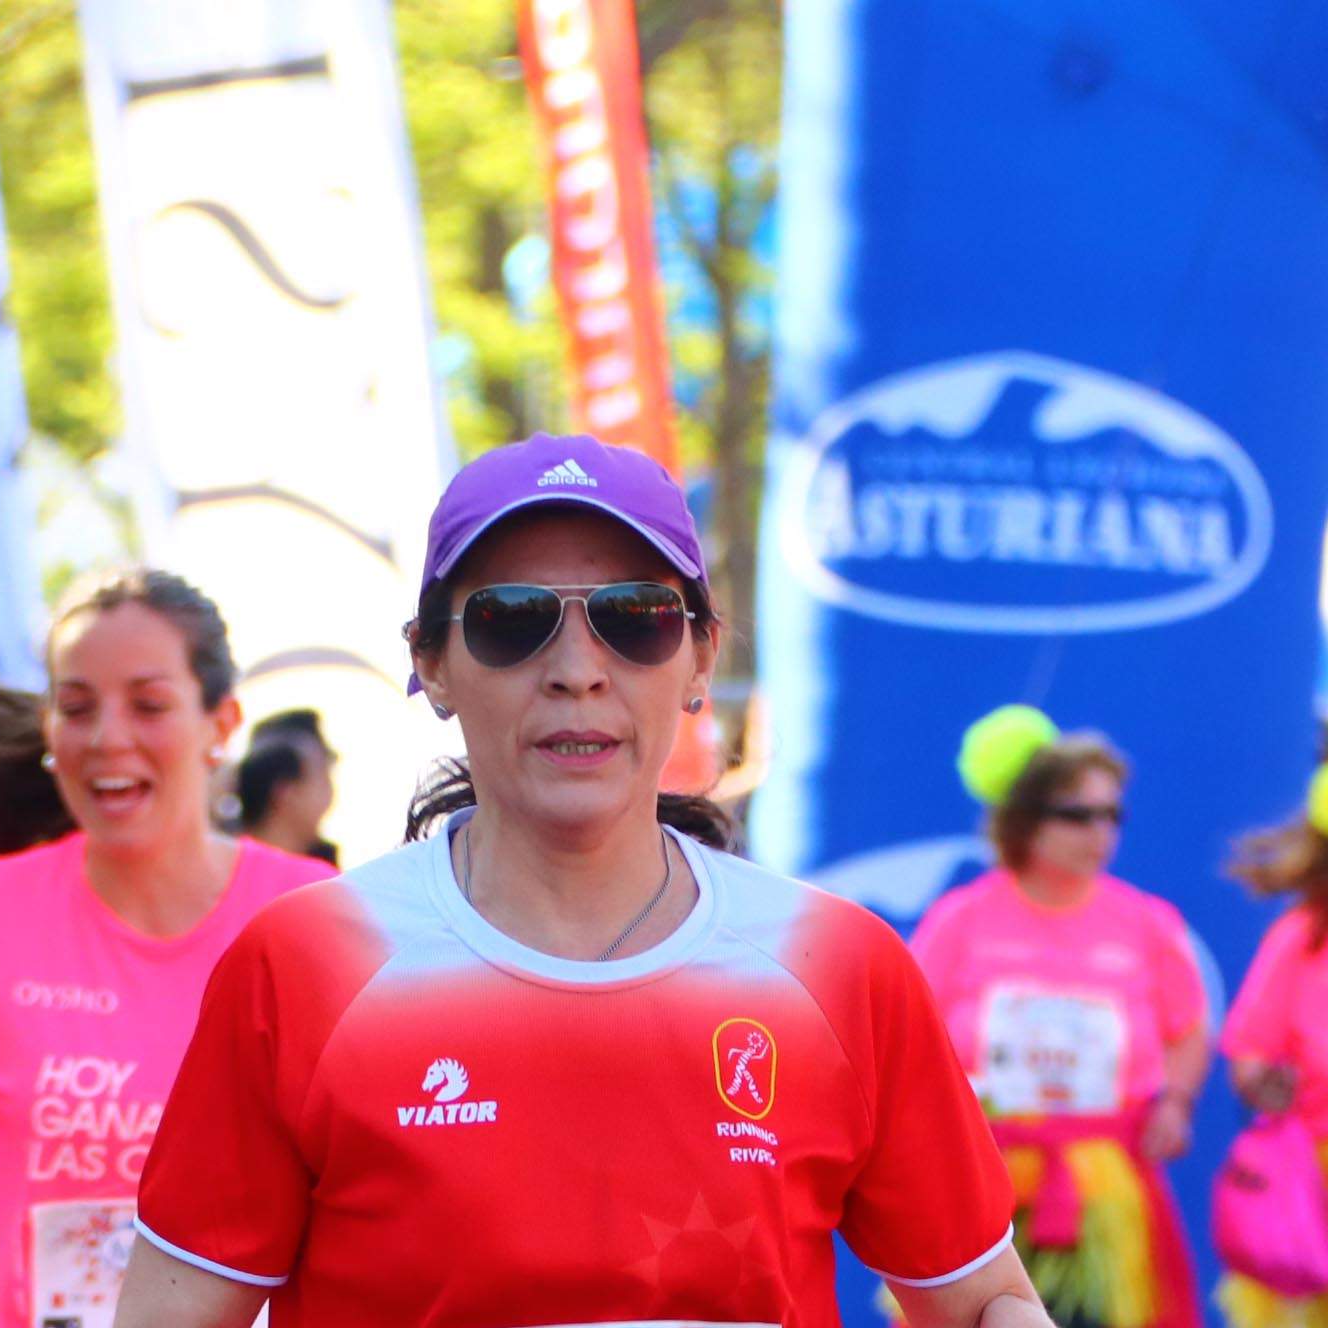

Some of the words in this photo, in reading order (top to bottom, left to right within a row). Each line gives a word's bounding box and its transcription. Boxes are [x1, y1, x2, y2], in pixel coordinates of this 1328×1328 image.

[537, 473, 598, 487] adidas
[35, 1055, 138, 1098] HOY
[397, 1101, 497, 1126] VIATOR
[716, 1121, 779, 1146] RUNNING
[26, 1141, 108, 1181] LAS
